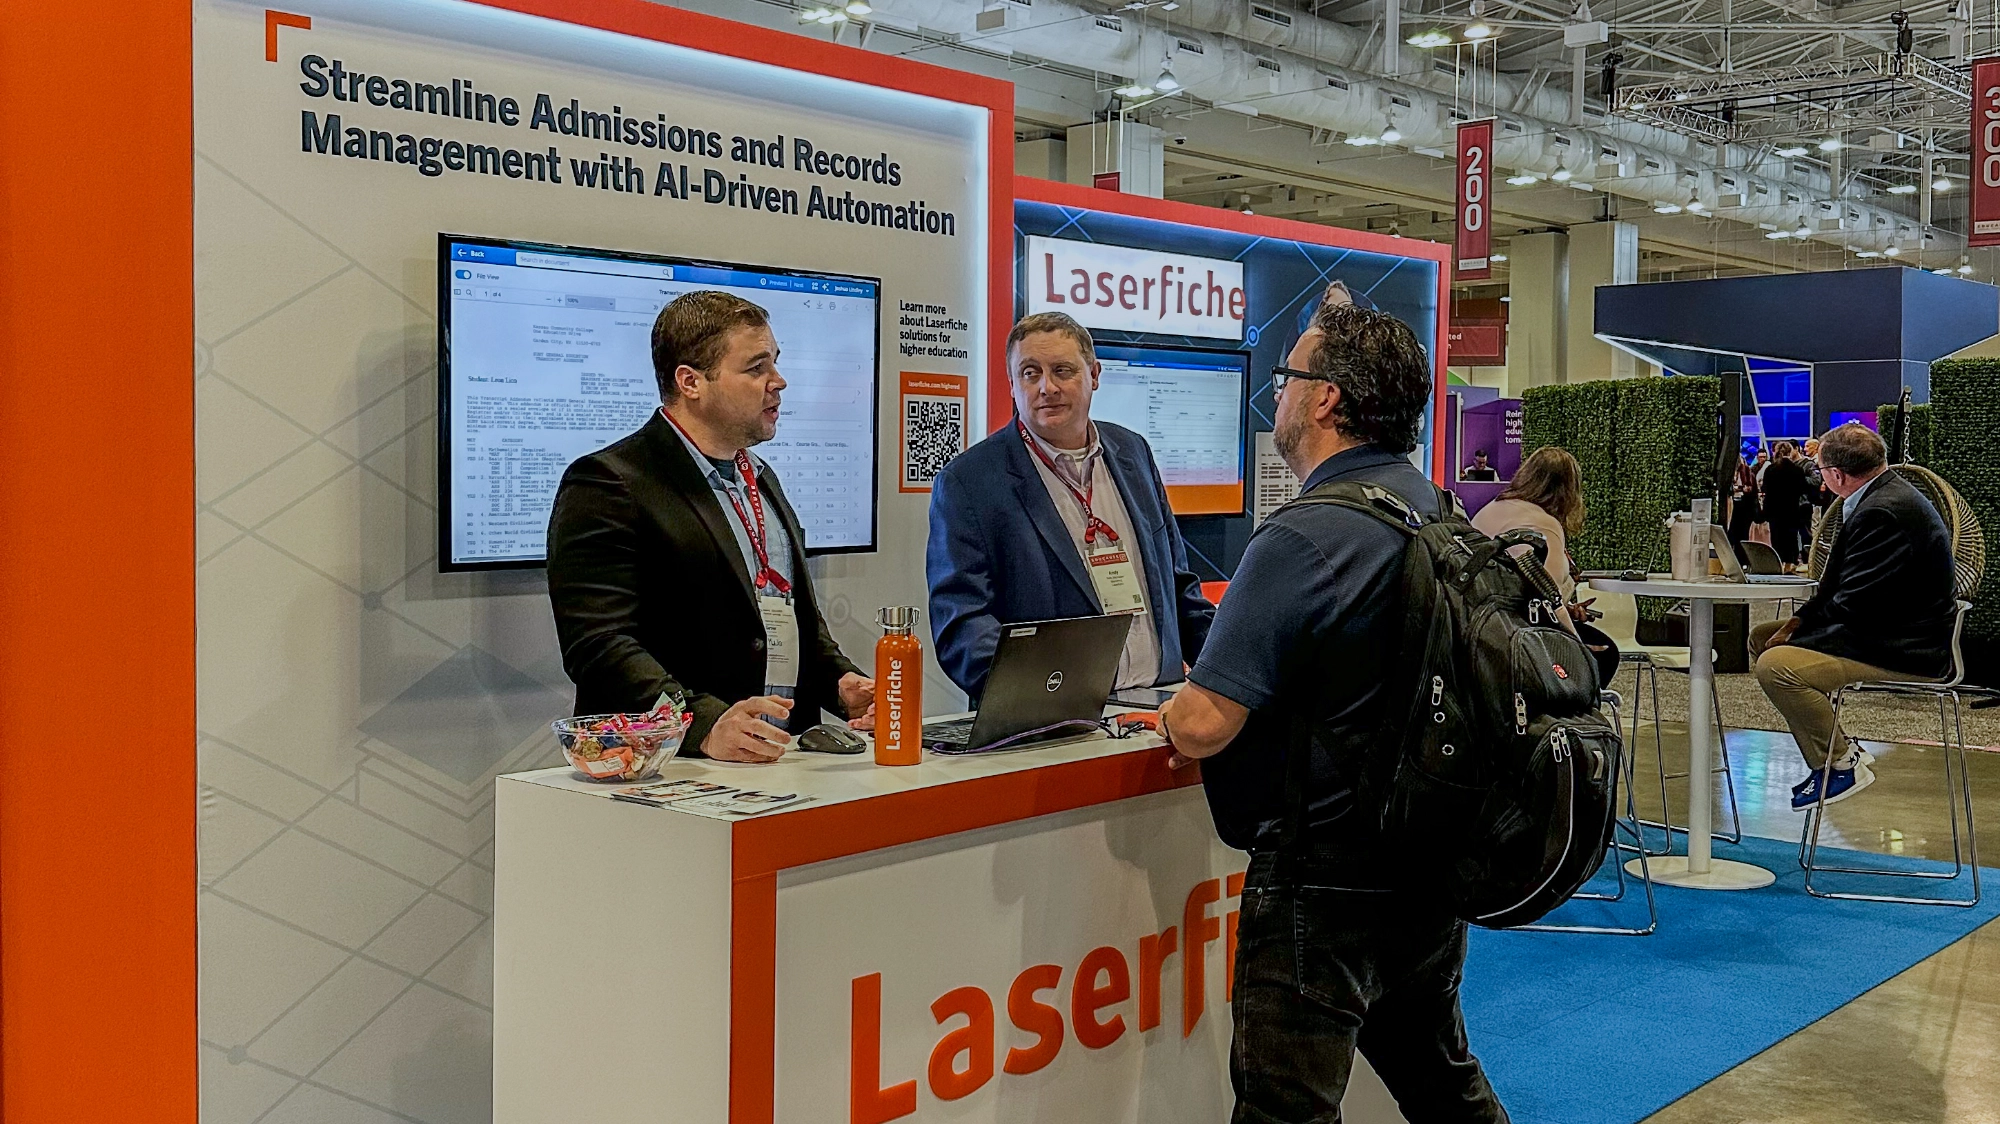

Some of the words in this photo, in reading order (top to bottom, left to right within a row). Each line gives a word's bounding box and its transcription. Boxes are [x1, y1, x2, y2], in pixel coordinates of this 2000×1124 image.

[300, 54, 520, 126] Streamline
[530, 93, 723, 158] Admissions
[731, 134, 785, 169] and
[794, 138, 901, 186] Records
[1984, 86, 2000, 188] 300
[301, 110, 561, 184] Management
[569, 152, 645, 194] with
[654, 162, 798, 216] AI-Driven
[806, 186, 955, 236] Automation
[1464, 146, 1483, 232] 200
[900, 300, 924, 312] Learn
[925, 304, 946, 315] more
[900, 314, 924, 327] about
[926, 316, 968, 331] Laserfiche
[1045, 252, 1246, 320] Laserfiche
[900, 329, 938, 342] solutions
[939, 332, 951, 343] for
[900, 343, 926, 357] higher
[928, 345, 968, 359] education
[886, 658, 904, 750] Laserfiche
